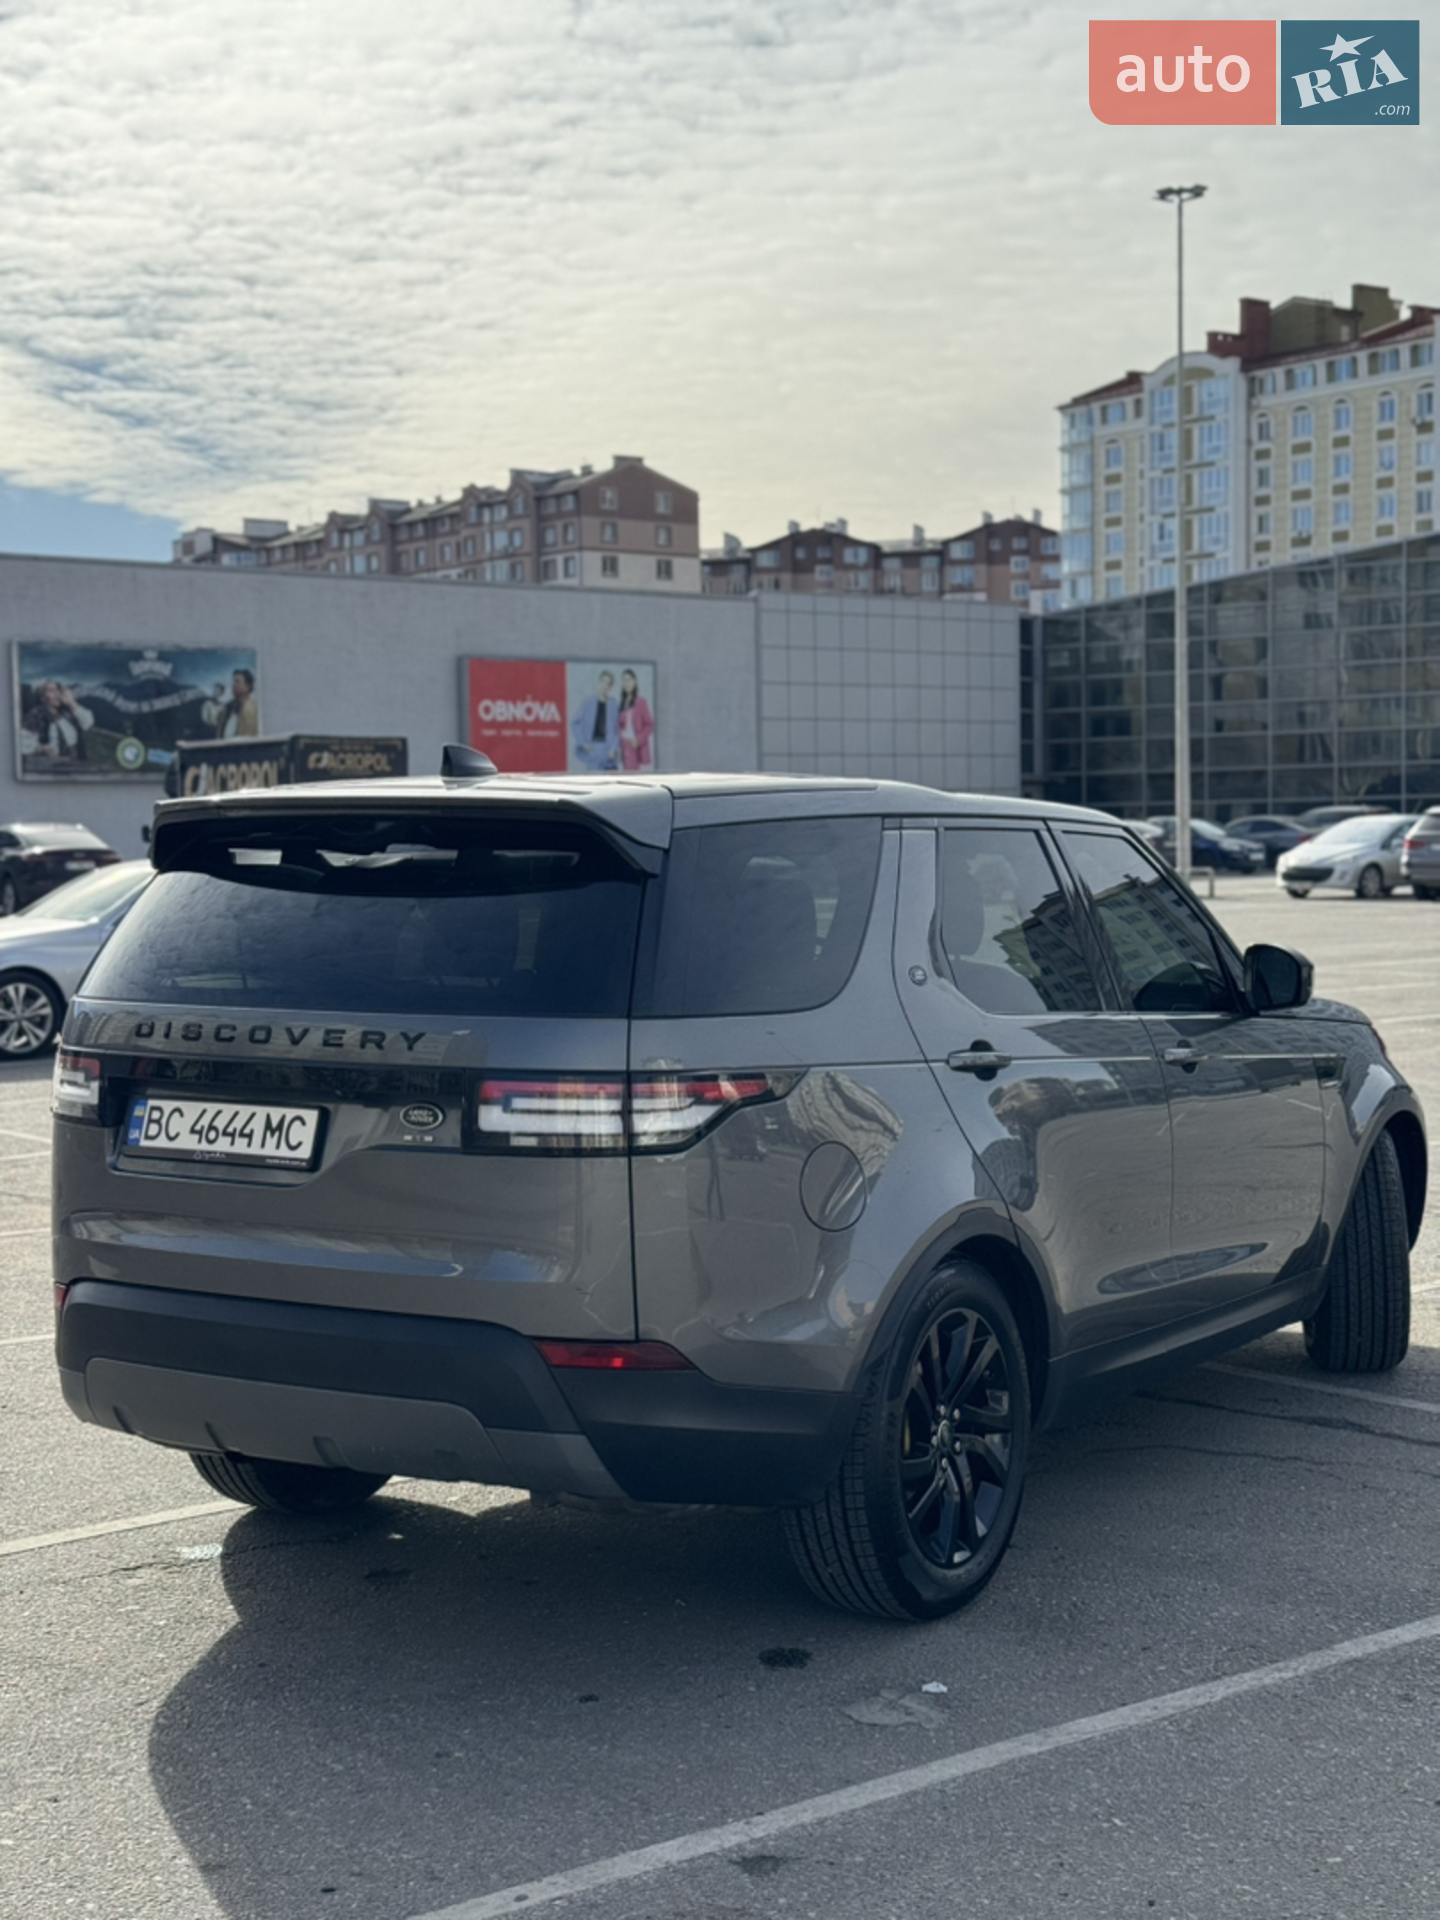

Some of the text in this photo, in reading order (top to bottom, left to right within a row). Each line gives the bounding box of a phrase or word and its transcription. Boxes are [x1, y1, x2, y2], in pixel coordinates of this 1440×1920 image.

[134, 1021, 429, 1051] DISCOVERY
[143, 1105, 307, 1151] BC 4644 MC
